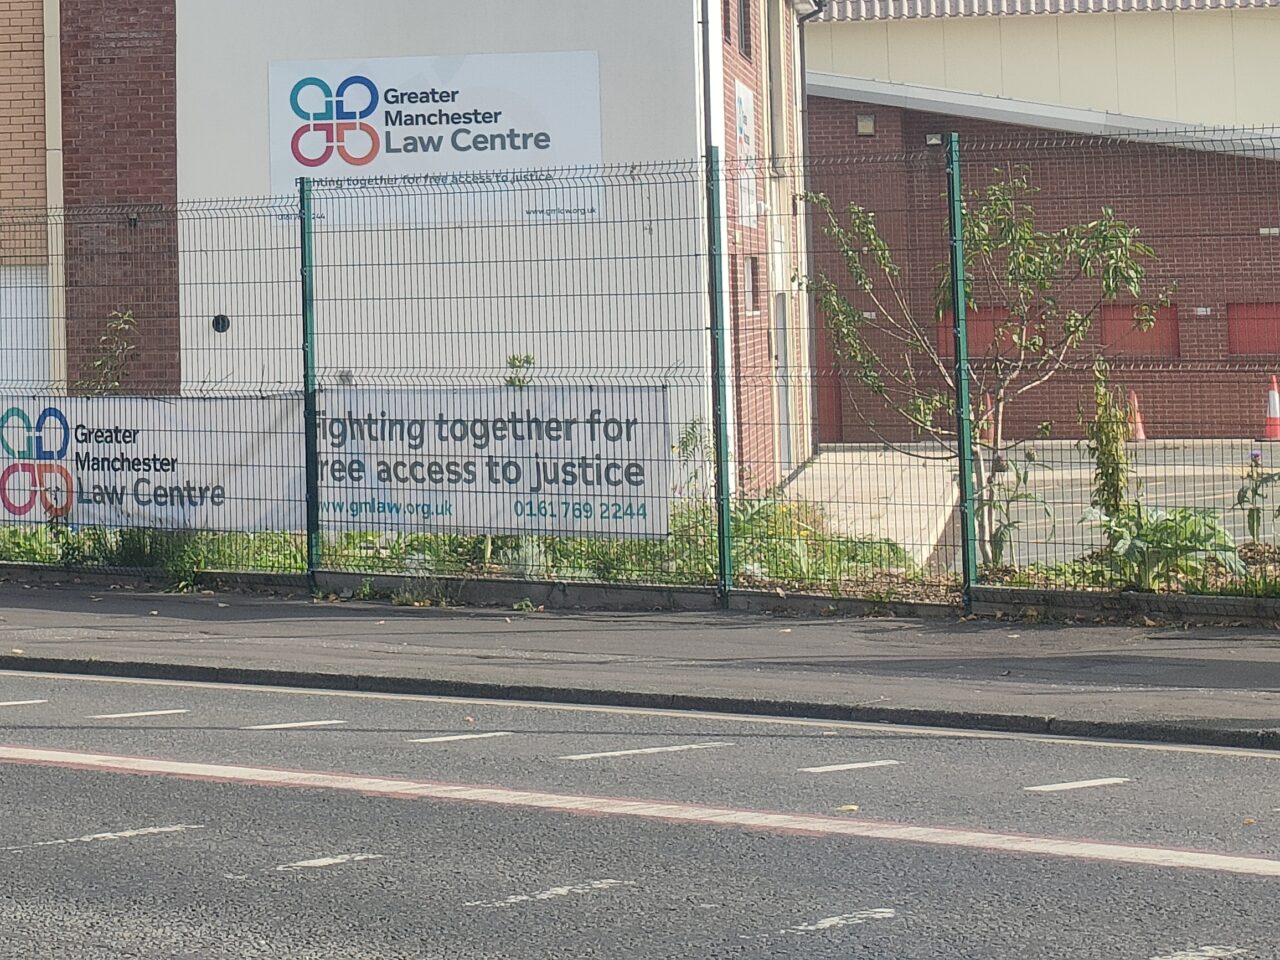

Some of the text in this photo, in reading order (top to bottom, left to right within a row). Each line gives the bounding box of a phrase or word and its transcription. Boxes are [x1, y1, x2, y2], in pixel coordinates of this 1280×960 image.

[384, 88, 459, 104] Greater
[384, 109, 502, 126] Manchester
[385, 128, 551, 153] Law Centre
[295, 176, 342, 188] Fhting
[74, 424, 139, 444] Greater
[434, 409, 577, 449] together
[586, 409, 638, 442] for
[75, 451, 177, 472] Manchester
[317, 452, 645, 492] ree access to justice
[76, 476, 225, 507] Law Centre
[514, 500, 556, 517] 0161
[561, 502, 593, 519] 769
[600, 503, 647, 520] 2244
